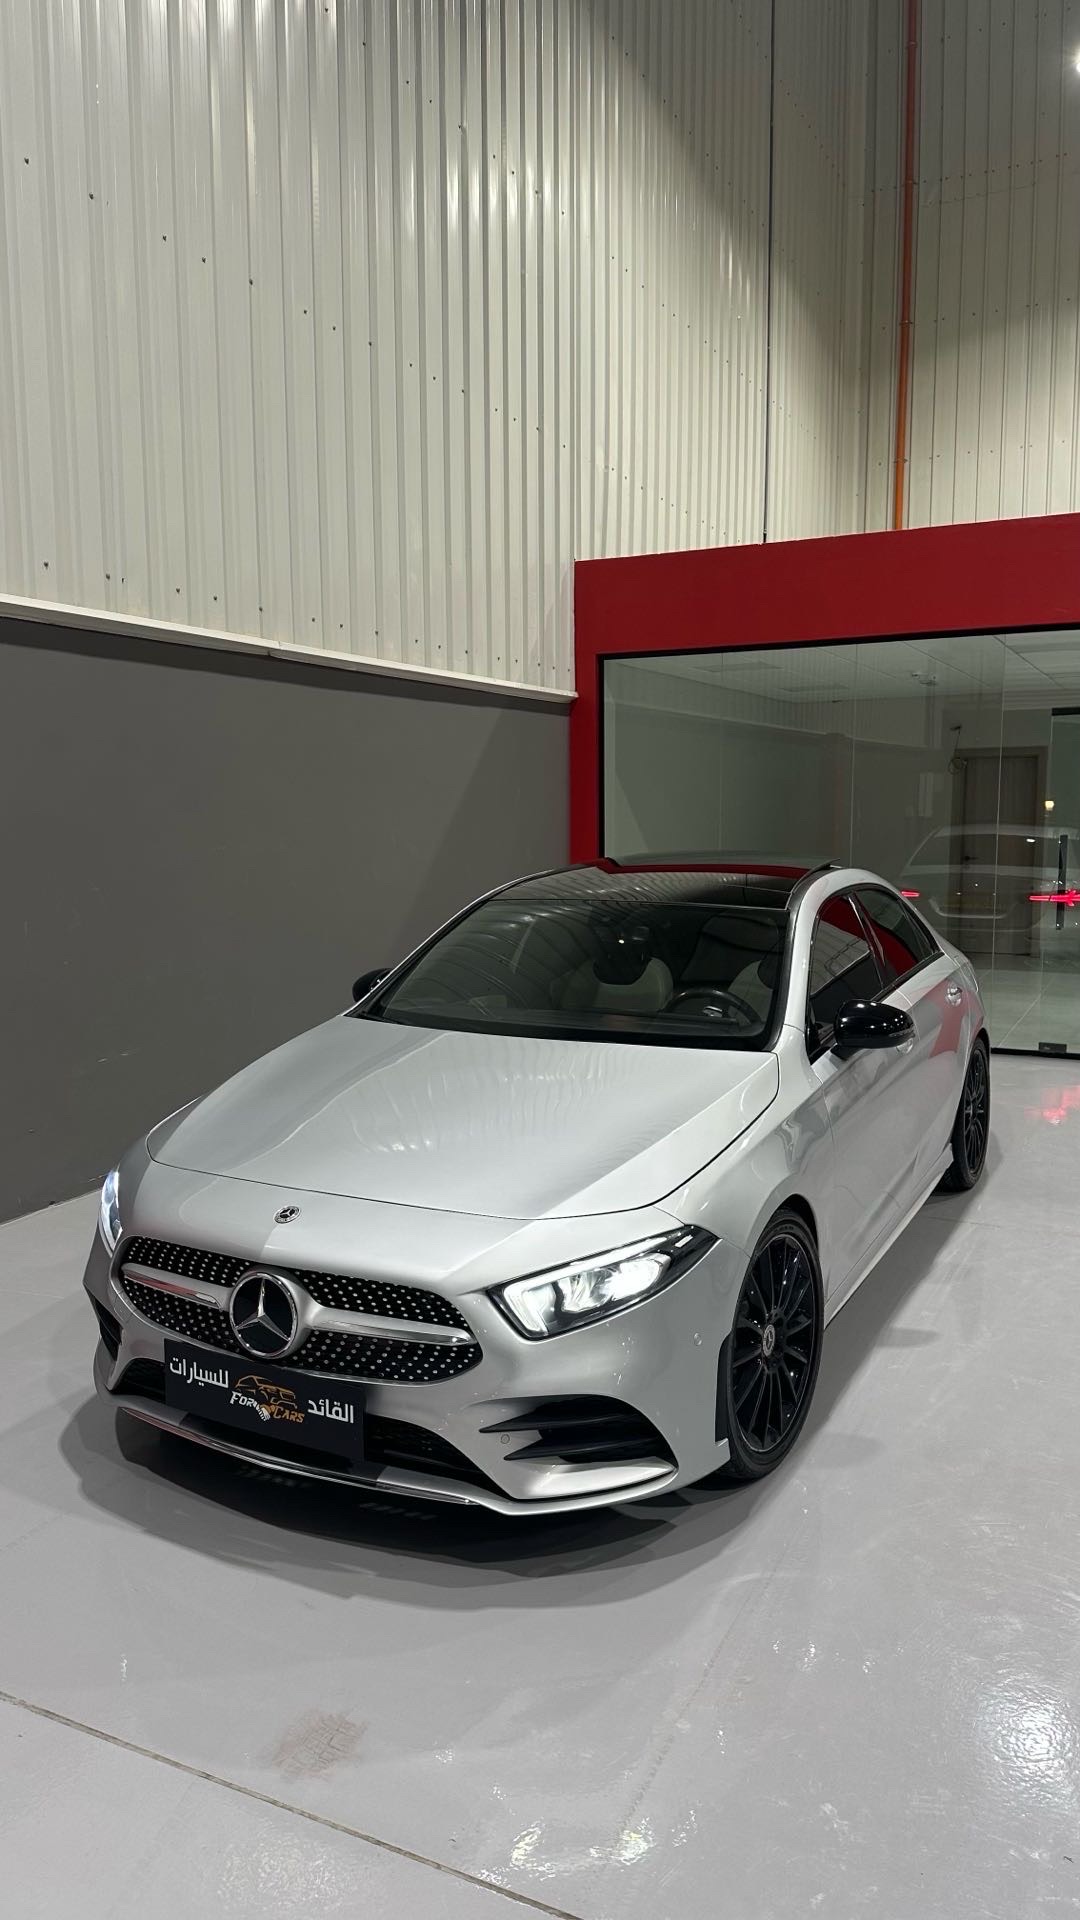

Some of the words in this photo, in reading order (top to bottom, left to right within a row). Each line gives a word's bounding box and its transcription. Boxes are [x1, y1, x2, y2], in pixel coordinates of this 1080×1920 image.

[169, 1356, 229, 1389] للسيارات
[273, 1406, 305, 1423] CARS
[307, 1398, 354, 1424] القائد
